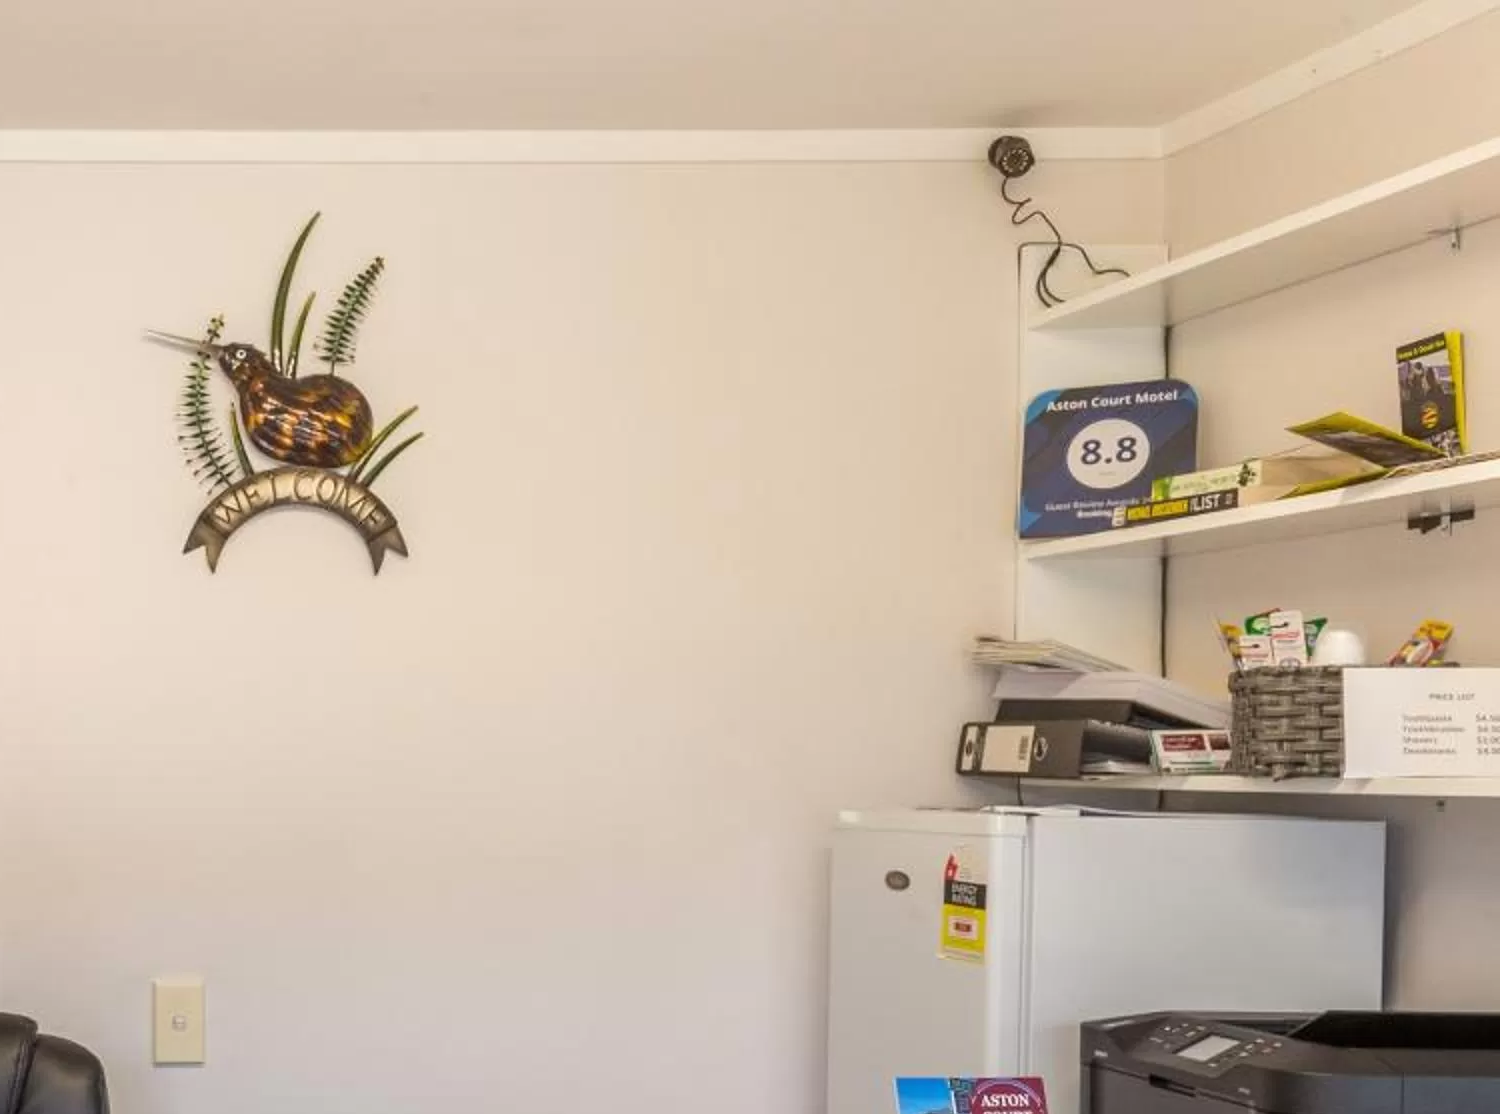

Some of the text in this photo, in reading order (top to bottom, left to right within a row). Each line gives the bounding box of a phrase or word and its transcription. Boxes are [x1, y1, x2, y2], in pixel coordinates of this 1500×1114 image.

[1046, 389, 1179, 414] Aston Court Motel
[1080, 437, 1138, 466] 8.8
[209, 470, 389, 525] WELCOME
[981, 1093, 1030, 1108] ASTON
